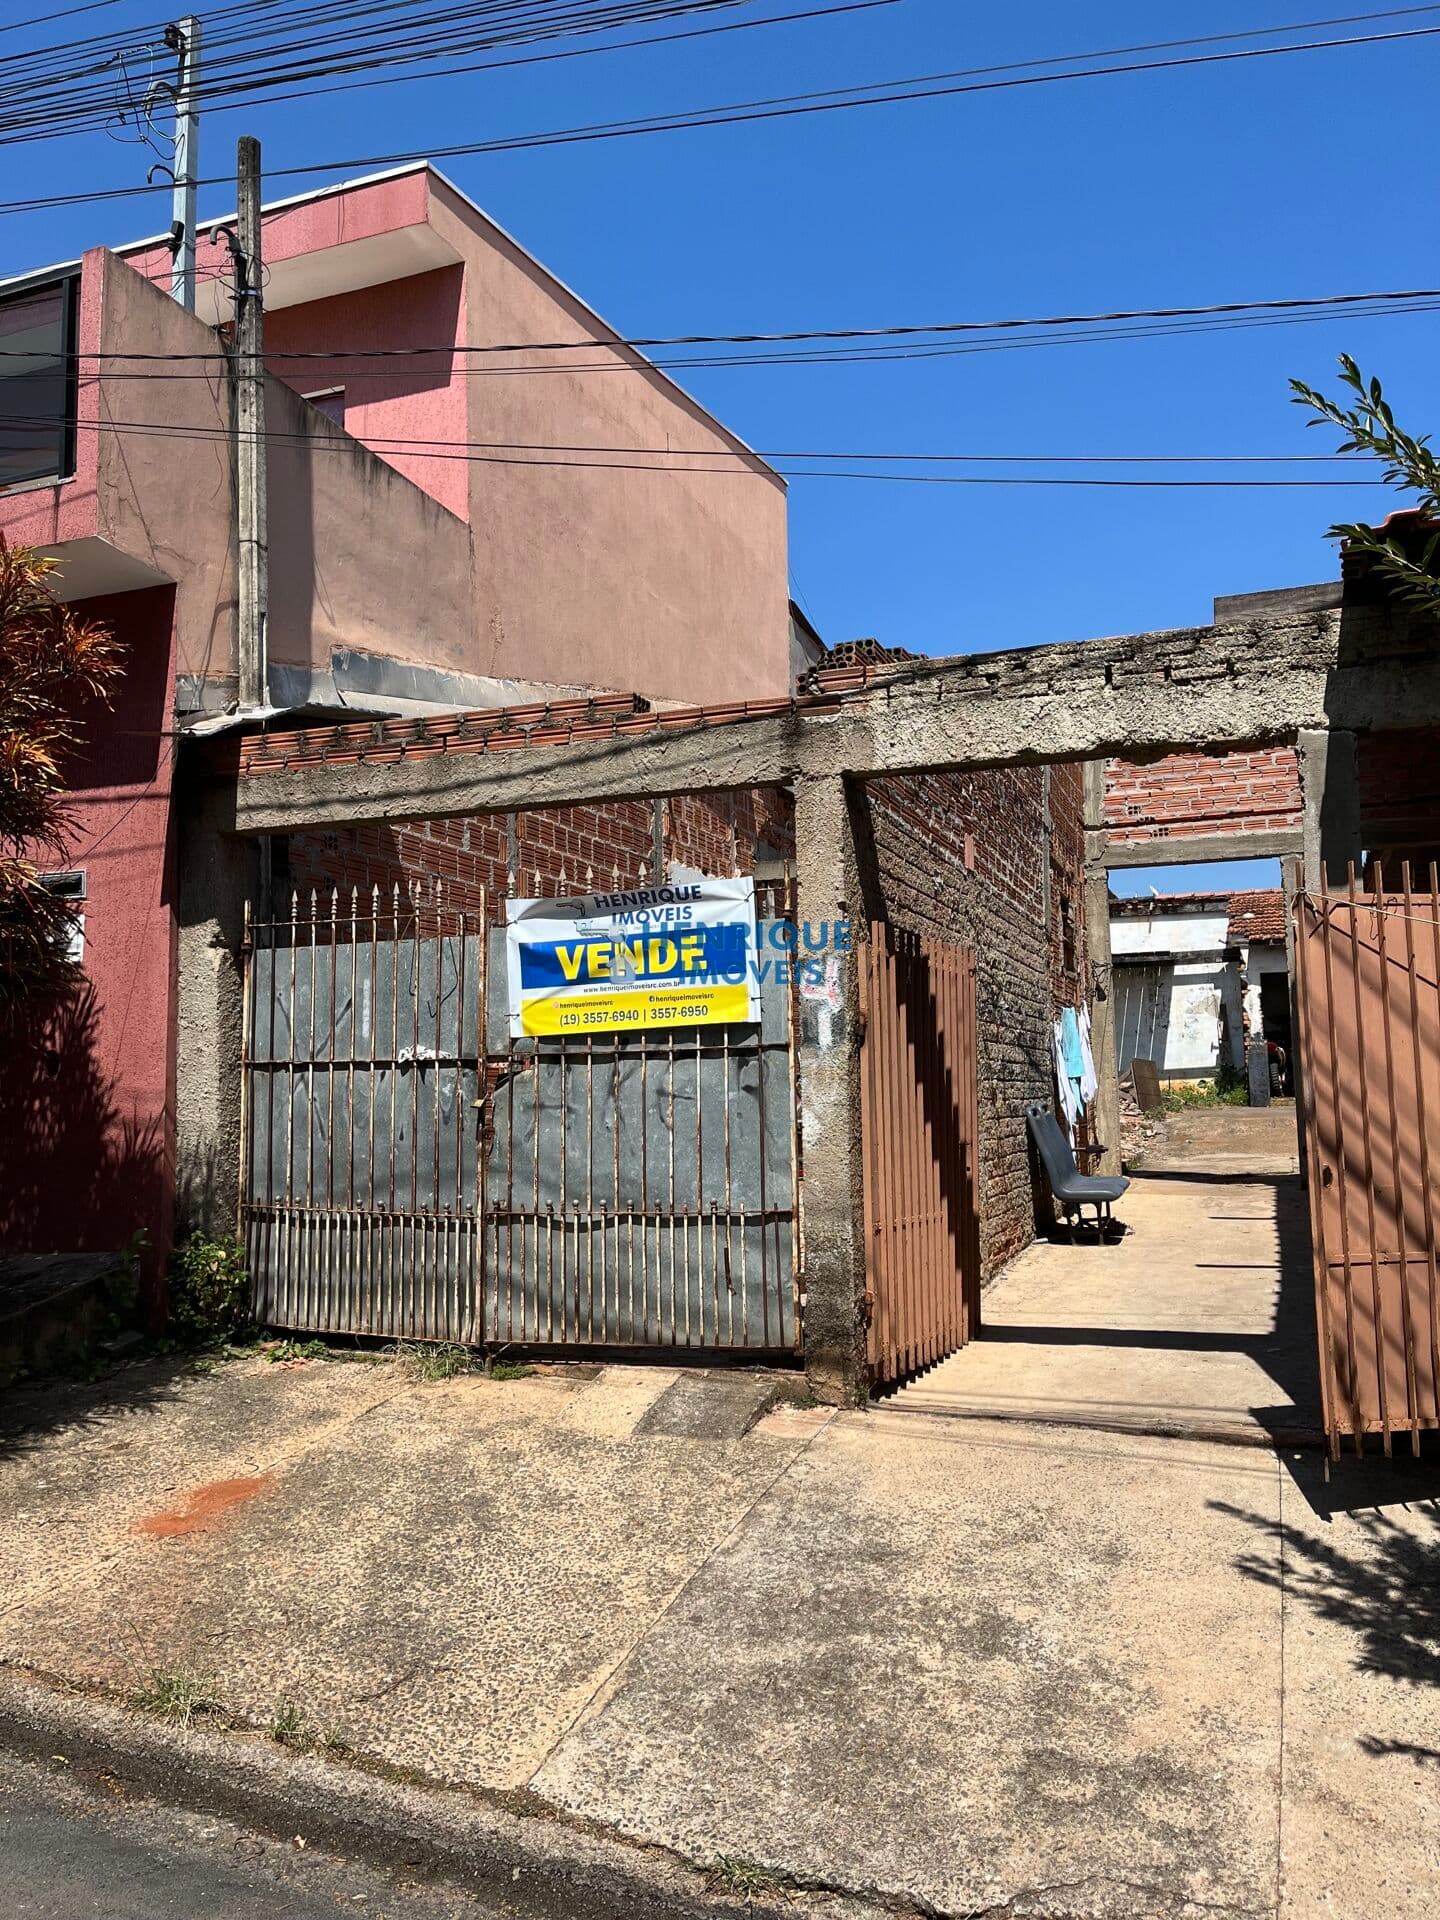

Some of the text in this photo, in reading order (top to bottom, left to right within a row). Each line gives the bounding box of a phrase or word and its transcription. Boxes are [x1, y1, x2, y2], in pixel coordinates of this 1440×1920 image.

[594, 885, 702, 909] HENRIQUE
[612, 905, 692, 926] IMÓVEIS
[555, 935, 707, 980] VENDE
[559, 1014, 580, 1027] (19)
[583, 1009, 639, 1024] 3557-6940
[651, 1005, 708, 1019] 3557-6950
